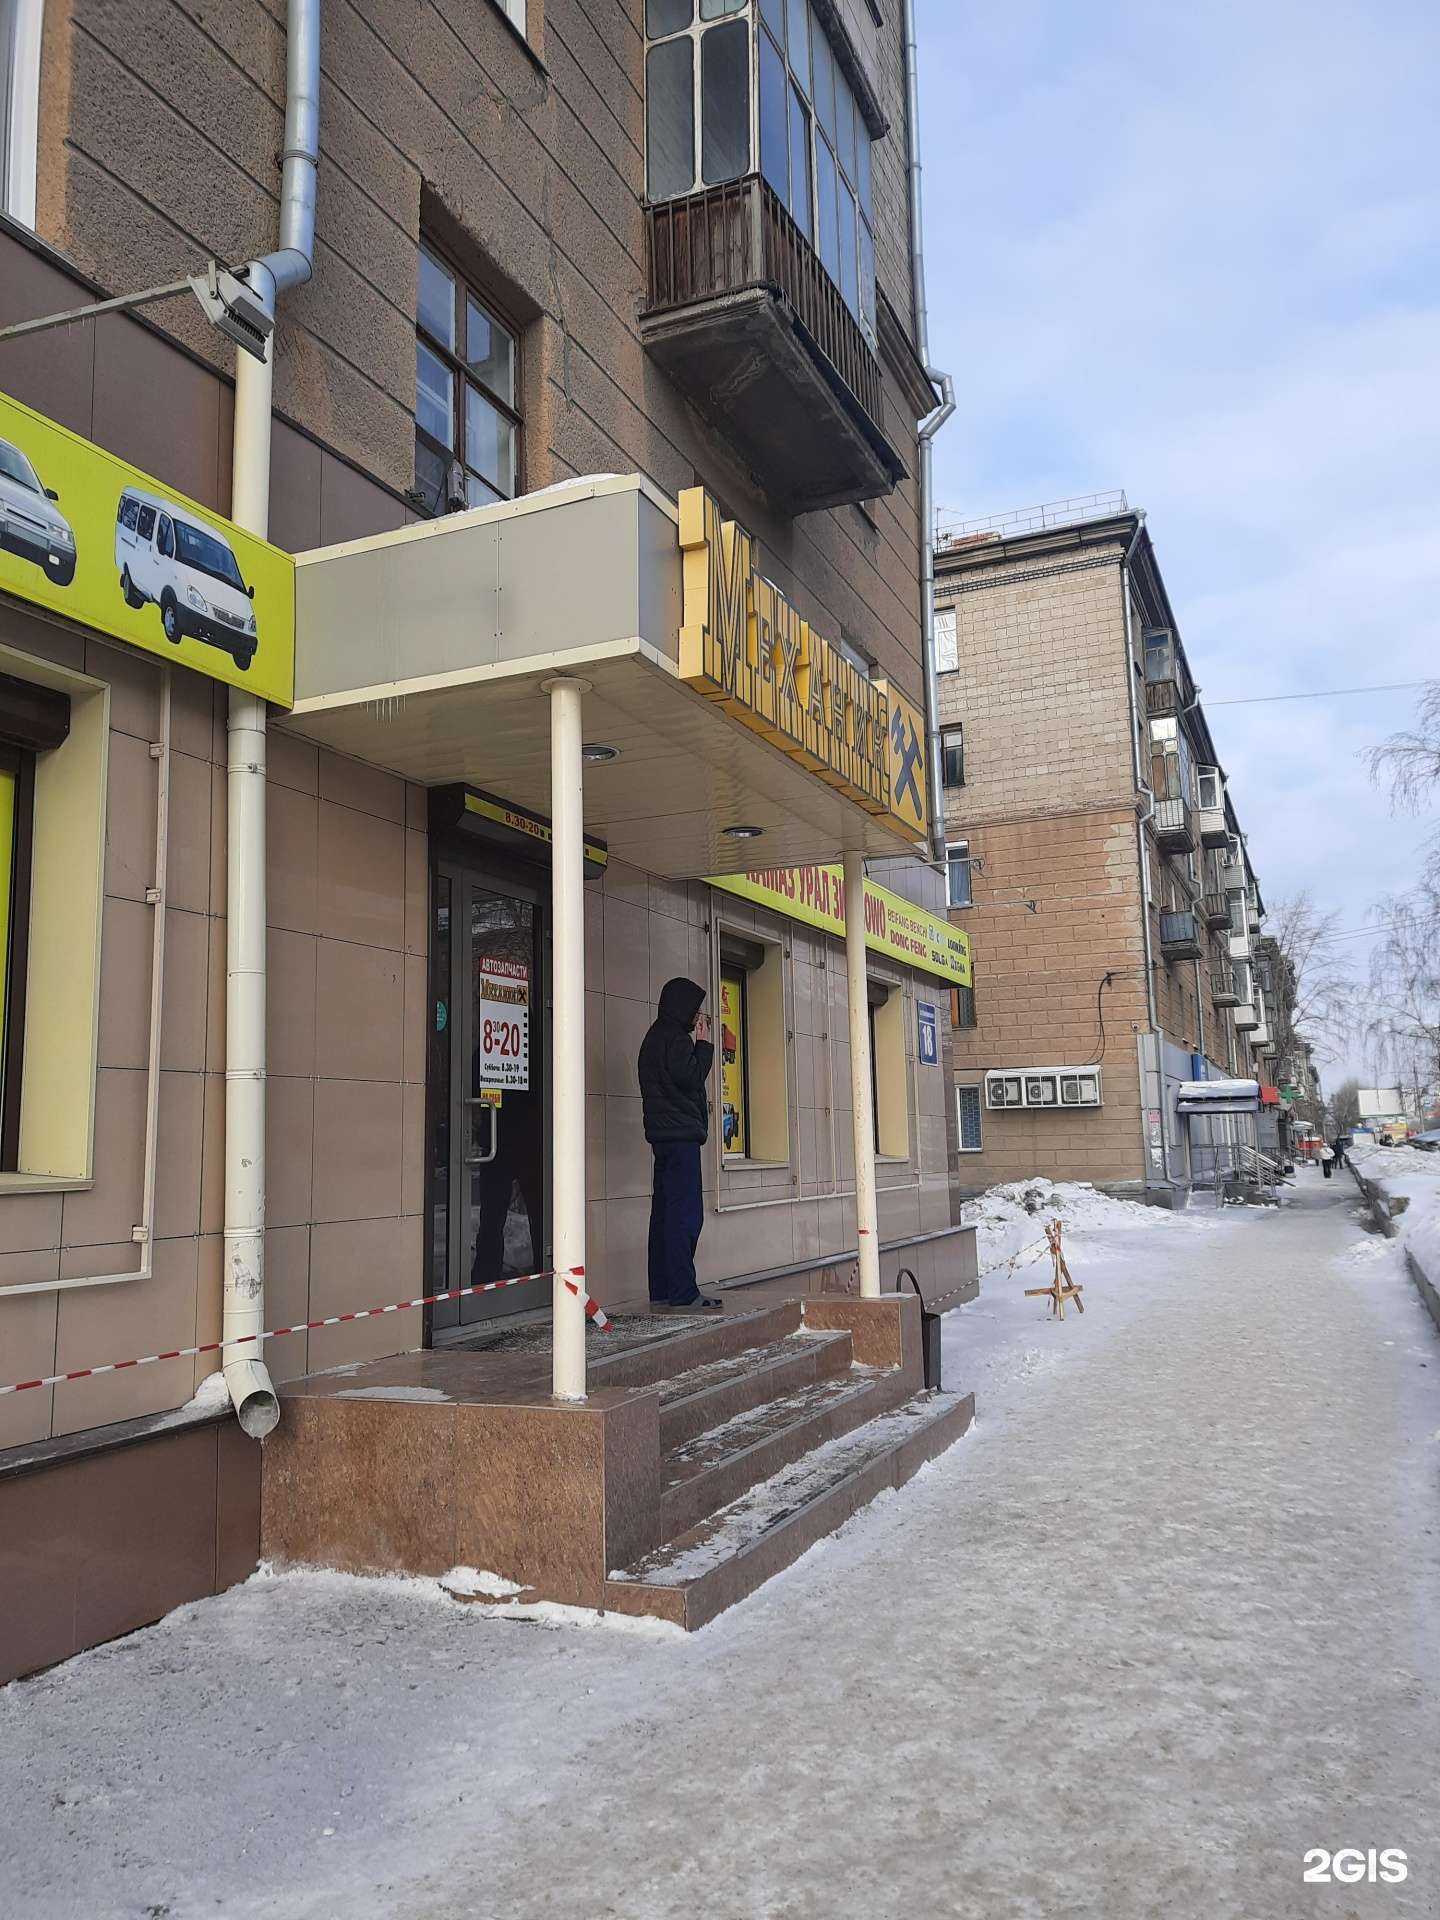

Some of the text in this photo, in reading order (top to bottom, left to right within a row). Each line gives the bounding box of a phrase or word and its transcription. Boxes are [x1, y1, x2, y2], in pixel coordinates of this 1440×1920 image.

[890, 929, 909, 951] DONG
[910, 939, 927, 958] FENG
[481, 958, 528, 979] АВТОЗАПЧАСТИ
[922, 1024, 933, 1056] 18
